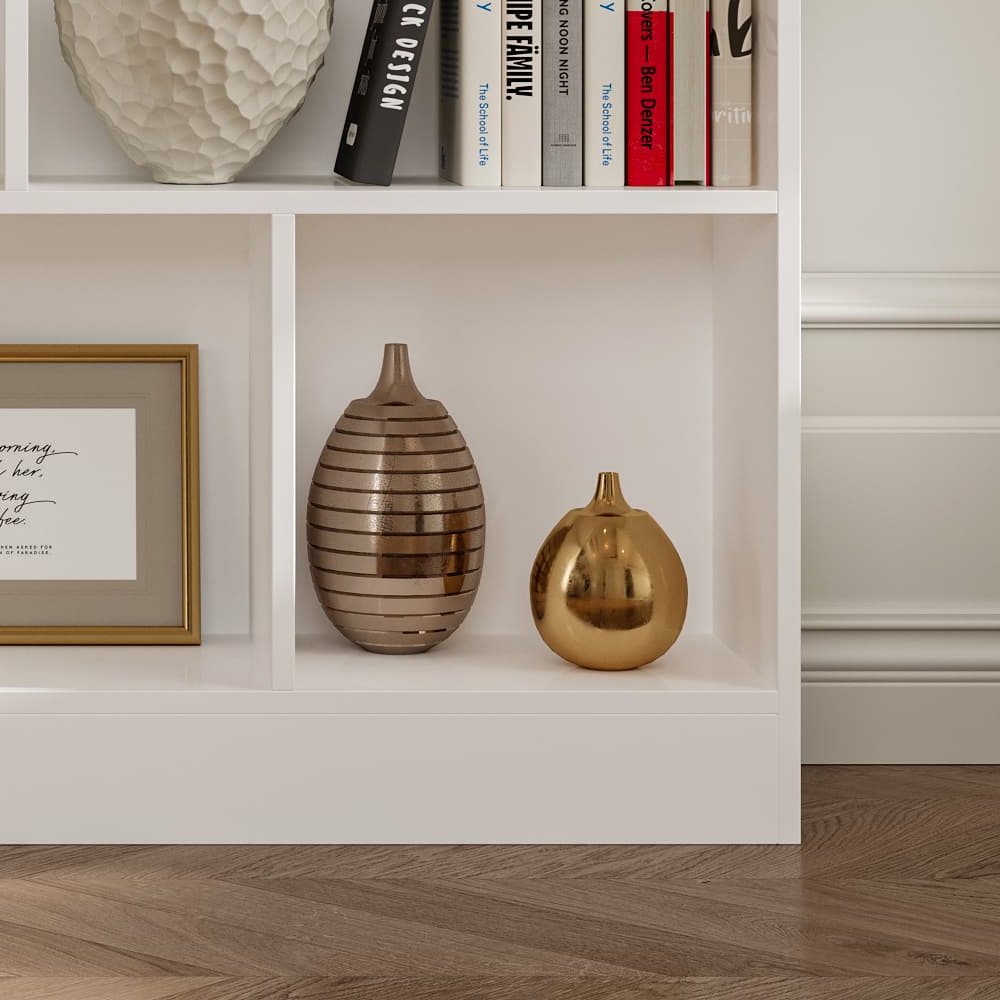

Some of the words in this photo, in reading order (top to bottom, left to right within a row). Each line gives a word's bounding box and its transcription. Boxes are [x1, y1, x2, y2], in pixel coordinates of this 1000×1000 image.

[559, 20, 568, 54] NOON
[378, 38, 419, 111] DESIGN
[506, 36, 539, 100] FÄMILY.
[559, 60, 568, 95] NIGHT
[640, 66, 656, 93] Ben
[480, 84, 488, 100] The
[603, 84, 611, 100] The
[480, 103, 488, 133] School
[603, 103, 612, 134] School
[640, 98, 656, 149] Denzer
[480, 137, 488, 146] of
[603, 137, 612, 146] of
[480, 149, 488, 166] Life
[603, 149, 611, 166] Life
